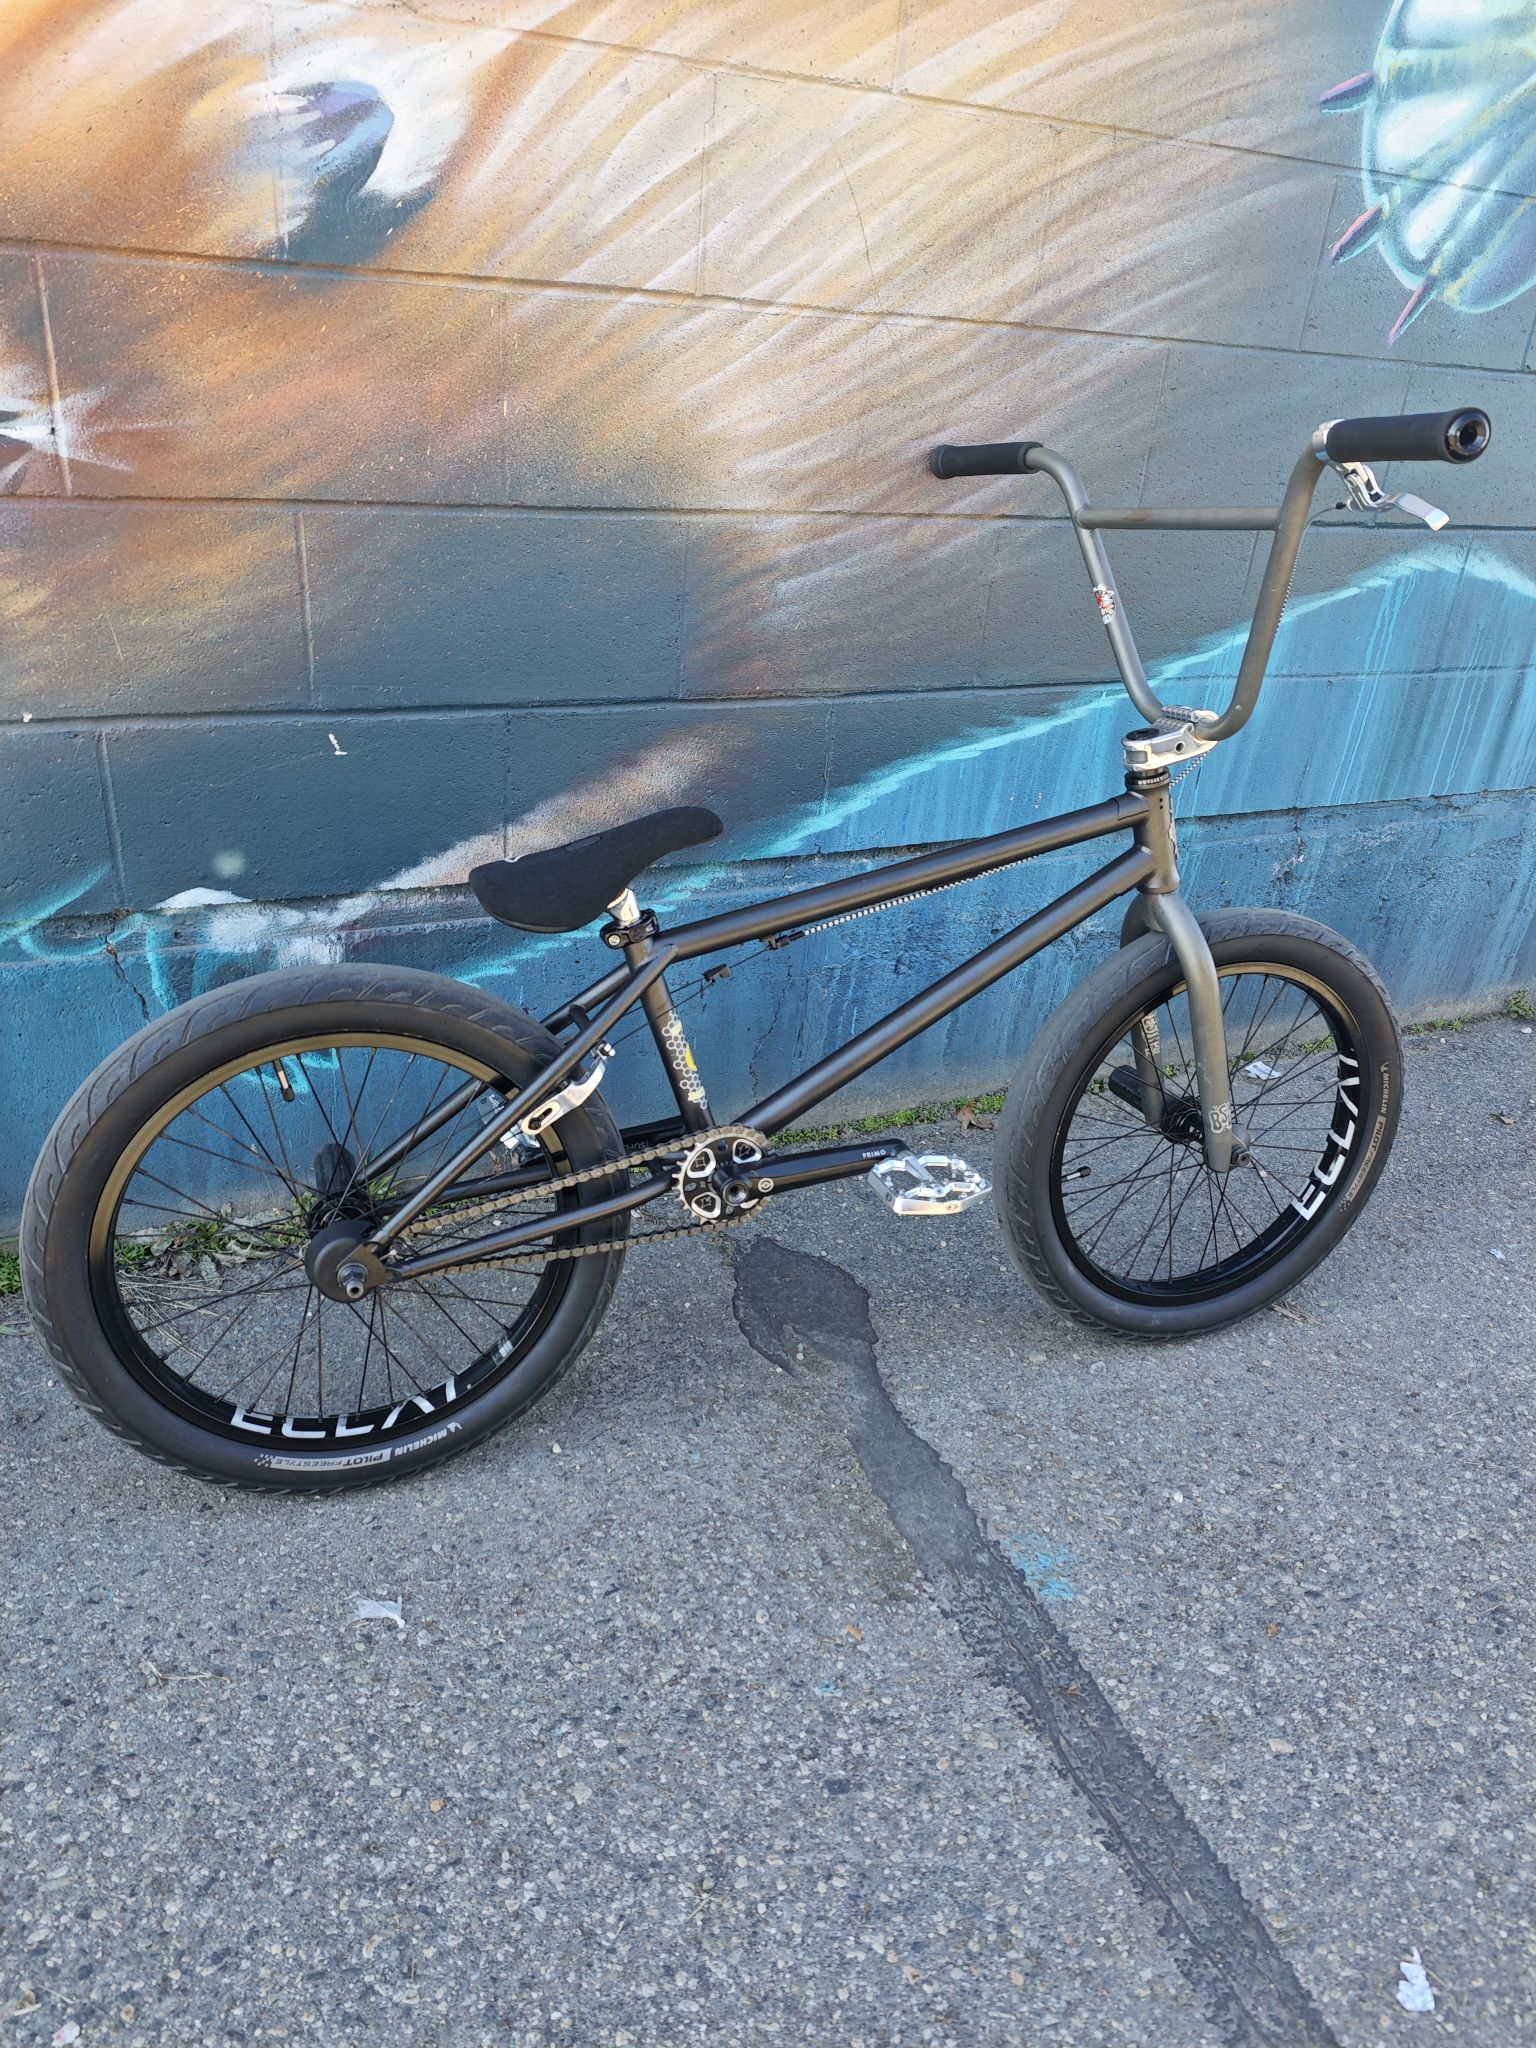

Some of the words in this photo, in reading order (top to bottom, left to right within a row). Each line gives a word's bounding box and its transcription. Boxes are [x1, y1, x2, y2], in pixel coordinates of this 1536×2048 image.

[1380, 1072, 1390, 1114] MICHELIN
[1208, 1102, 1232, 1134] BS
[1372, 1121, 1384, 1151] PILOT
[862, 1149, 887, 1159] PRIMO
[1347, 1150, 1374, 1198] FREESTYLE
[394, 1428, 448, 1457] MICHELIN
[277, 1458, 342, 1467] FREESTYLE
[342, 1452, 384, 1467] PILOT
